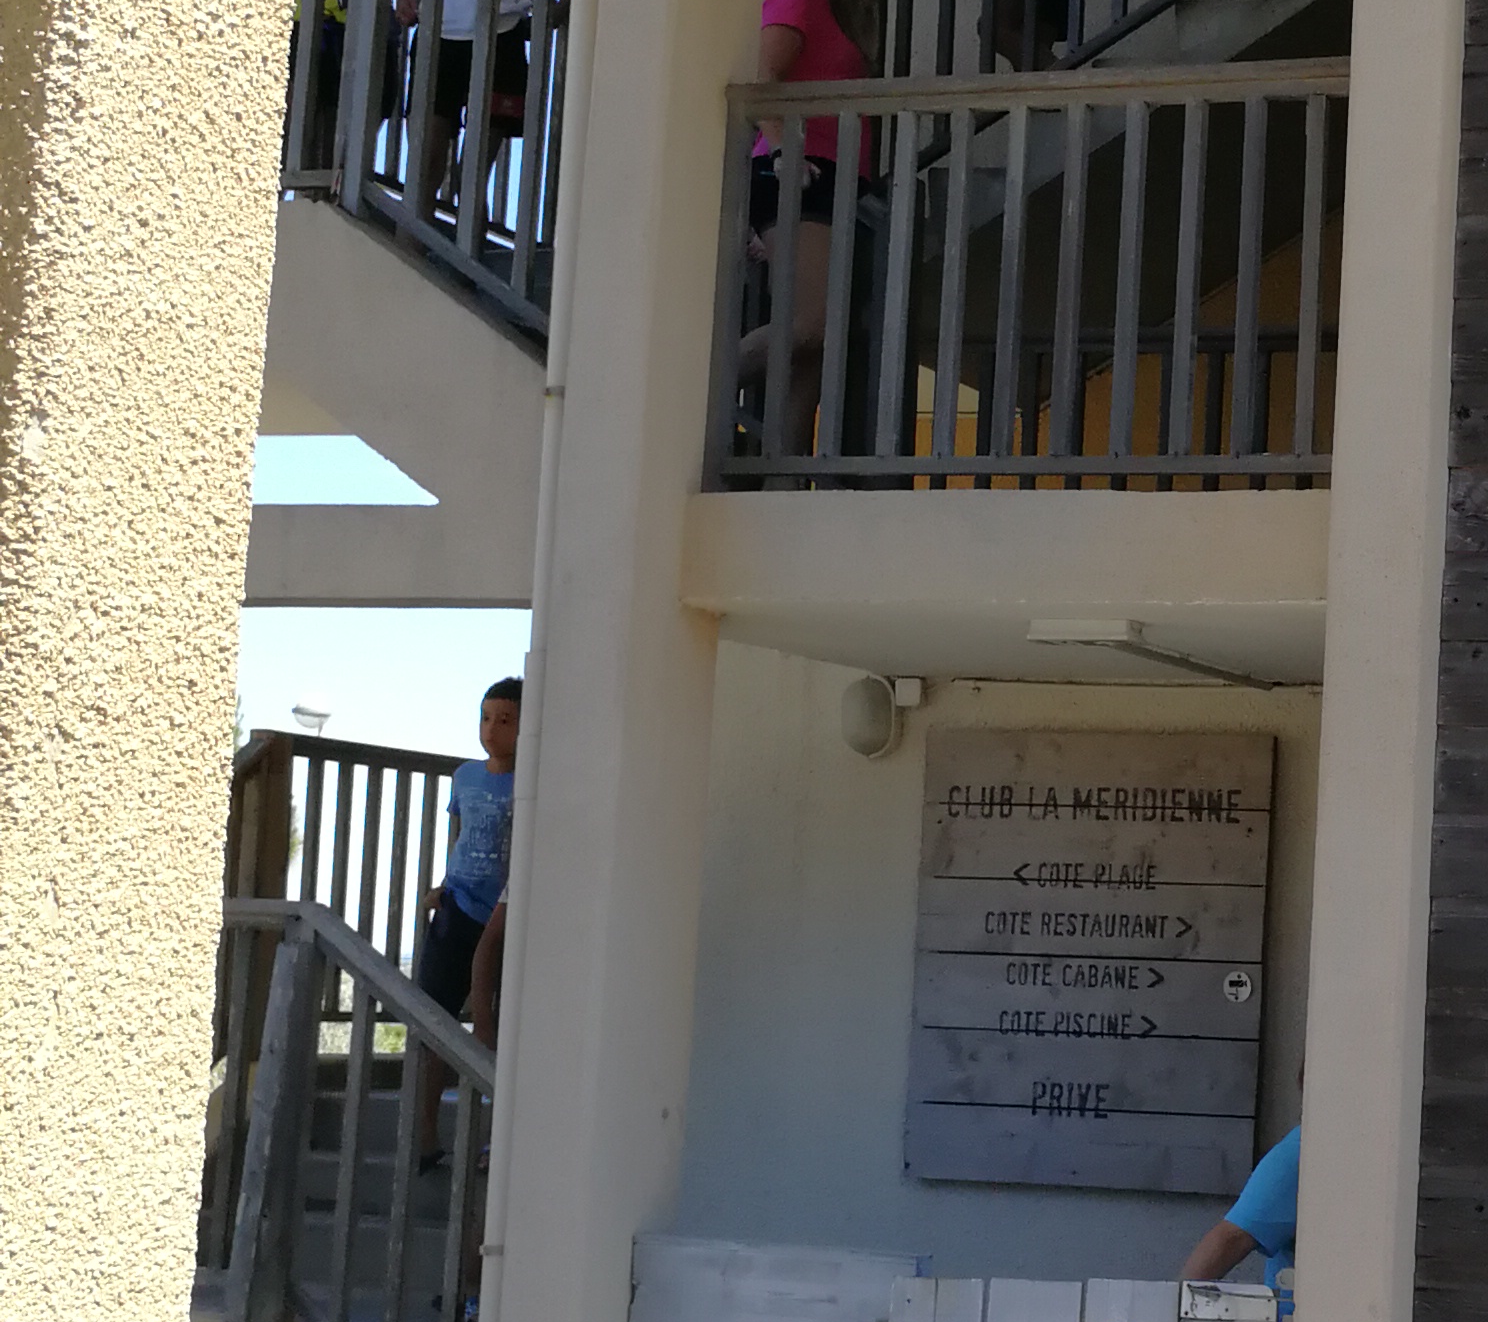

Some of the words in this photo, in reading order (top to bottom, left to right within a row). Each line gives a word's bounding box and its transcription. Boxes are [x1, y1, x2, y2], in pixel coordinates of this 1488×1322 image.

[947, 784, 1014, 820] CLUB
[1027, 785, 1059, 822] LA
[1072, 786, 1243, 824] MERIDIENNE
[1037, 862, 1085, 889] COTE
[1092, 863, 1158, 890] PLAGE
[984, 910, 1032, 936] COTE
[1040, 911, 1169, 939] RESTAURANT
[1005, 961, 1053, 987] COTE
[1061, 963, 1140, 990] CABANE
[999, 1010, 1047, 1038] COTE
[1053, 1012, 1133, 1040] PISCINE
[1030, 1080, 1111, 1119] PRIVE
